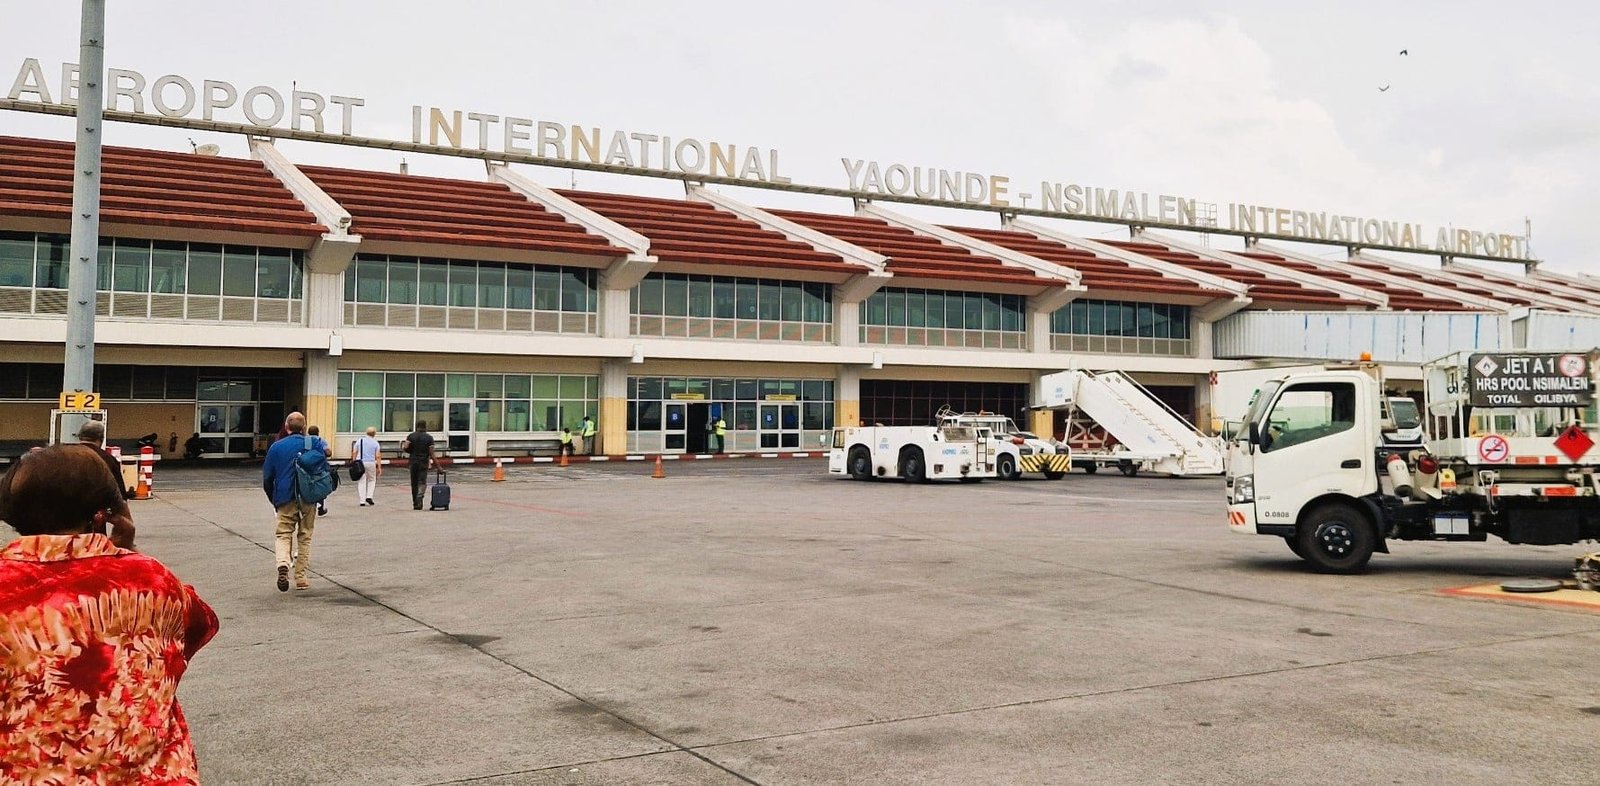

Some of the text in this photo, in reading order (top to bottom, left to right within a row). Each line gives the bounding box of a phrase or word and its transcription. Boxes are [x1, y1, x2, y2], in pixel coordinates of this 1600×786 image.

[7, 57, 365, 136] AEROPORT
[412, 105, 792, 184] INTERNATIONAL
[841, 157, 1011, 207] YAOUNDE
[1041, 180, 1197, 226] NSIMALEN
[1228, 202, 1429, 251] INTERNATIONAL
[1435, 225, 1526, 259] AIRPORT
[1502, 357, 1555, 375] JET A 1
[1476, 376, 1588, 392] HRS POOL NSIMALEN
[65, 394, 95, 408] E 2
[1486, 394, 1578, 404] TOTAL OILIBYA
